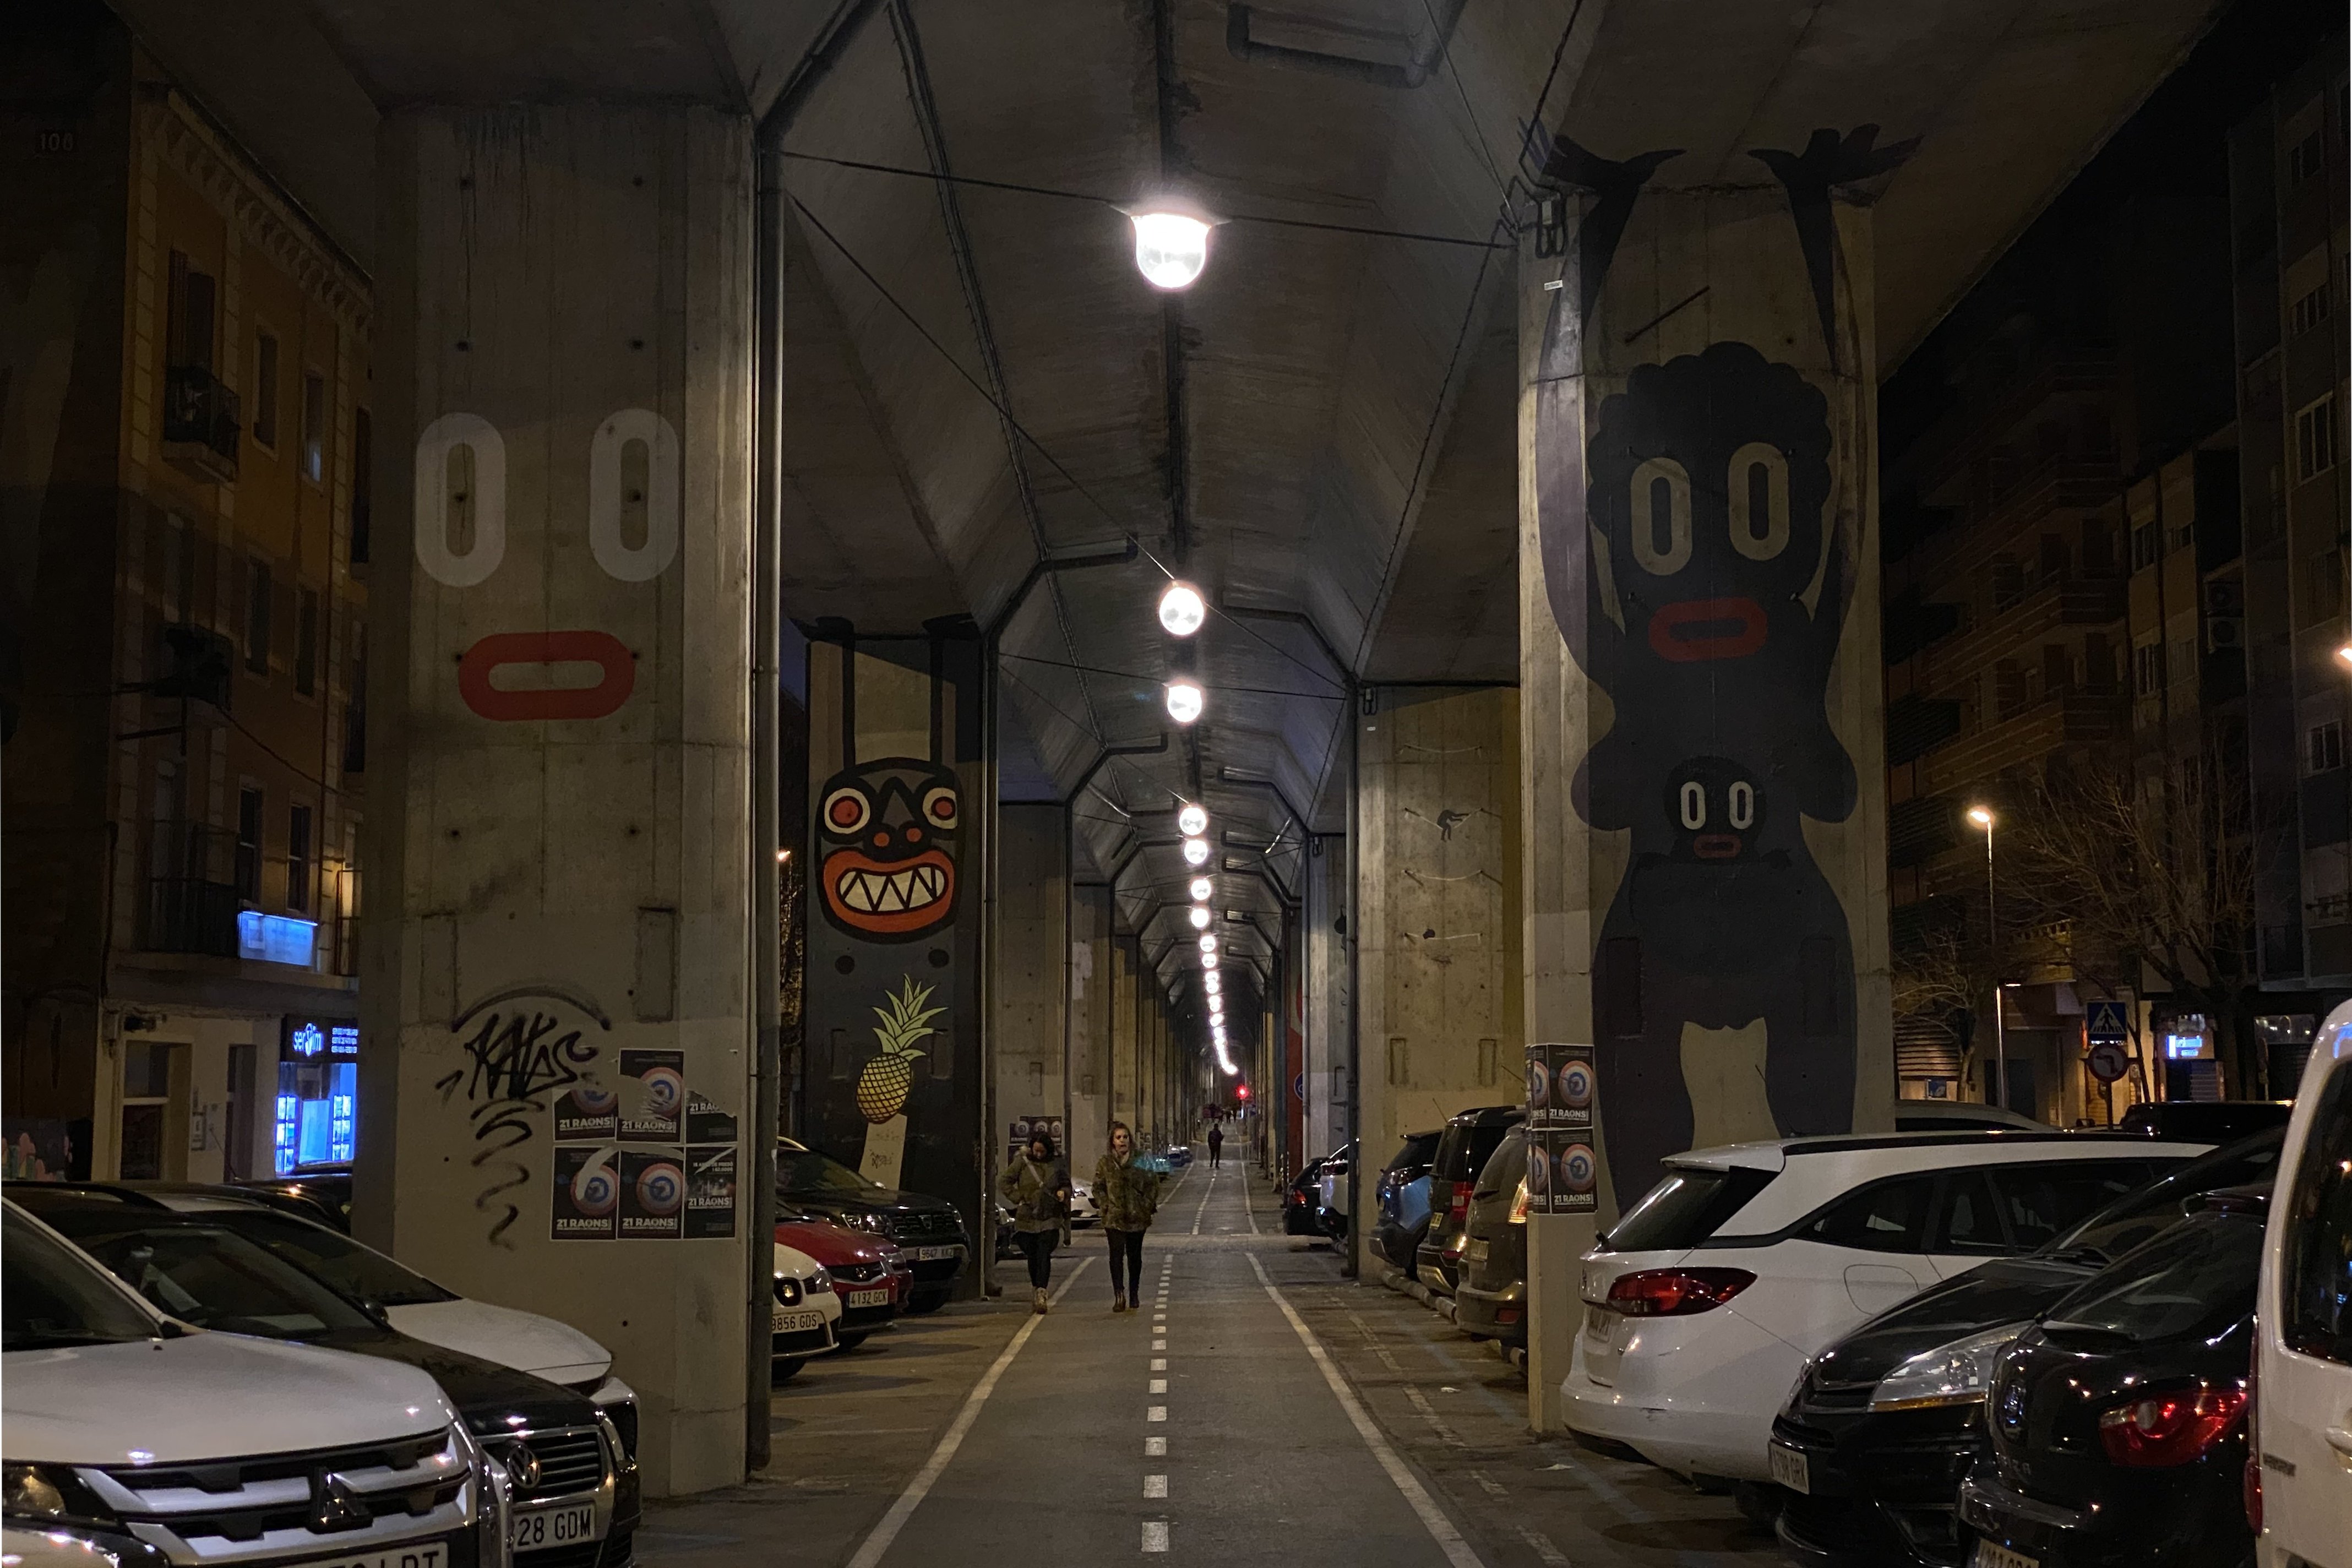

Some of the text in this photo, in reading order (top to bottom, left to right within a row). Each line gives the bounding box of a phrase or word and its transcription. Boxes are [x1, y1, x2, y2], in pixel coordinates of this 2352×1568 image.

[1549, 1108, 1586, 1118] 21 RAONS
[559, 1117, 611, 1128] 21 RAONS
[622, 1120, 632, 1129] 21
[688, 1197, 729, 1206] 21 RAONS
[1554, 1194, 1591, 1203] 21 RAONS
[556, 1218, 608, 1227] 21 RAONS
[622, 1217, 674, 1227] 21 RAONS
[851, 1290, 887, 1304] 4132 GCK
[799, 1314, 816, 1328] GDS
[517, 1509, 591, 1547] 28 GDM
